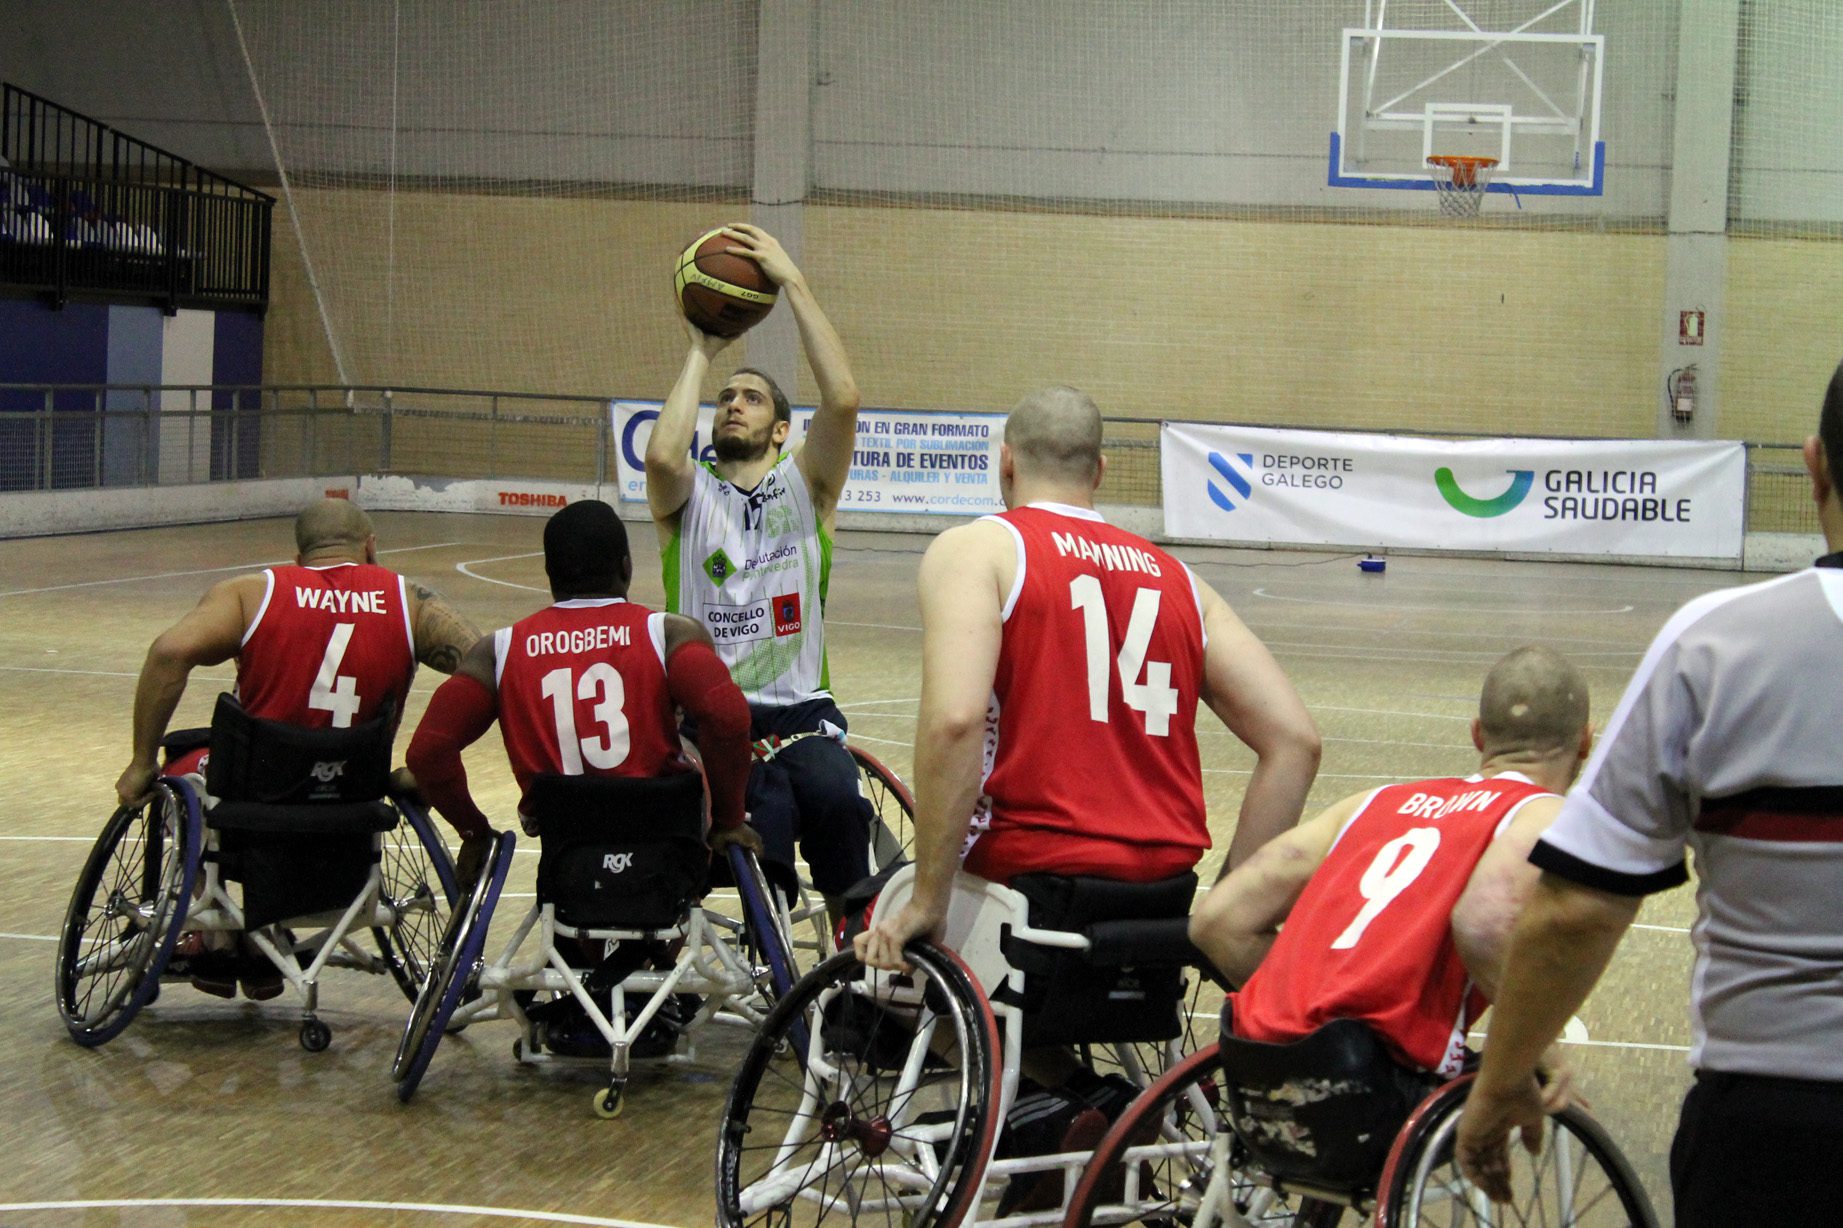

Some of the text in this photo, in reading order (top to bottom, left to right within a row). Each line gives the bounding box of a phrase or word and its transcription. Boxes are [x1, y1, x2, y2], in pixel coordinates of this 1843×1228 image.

[875, 421, 890, 434] EN
[894, 422, 928, 436] GRAN
[932, 423, 989, 438] FORMATO
[861, 436, 892, 448] TEXTIL
[896, 438, 917, 449] POR
[852, 450, 989, 471] TURA DE EVENTOS
[1263, 454, 1353, 472] DEPORTE
[849, 468, 879, 481] URAS
[889, 470, 940, 484] ALQUILER
[944, 472, 951, 484] Y
[955, 472, 988, 485] VENTA
[1262, 472, 1343, 490] GALEGO
[1545, 469, 1657, 494] GALICIA
[498, 492, 568, 507] TOSHIBA
[857, 490, 881, 503] 253
[892, 493, 1005, 507] www.cordecom.c
[1544, 496, 1691, 523] SAUDABLE
[1051, 531, 1162, 578] MANNING
[295, 586, 388, 615] WAYNE
[707, 607, 765, 624] CONCELLO
[714, 623, 760, 638] DE VIGO
[777, 621, 801, 633] VIGO
[526, 625, 631, 657] OROGBEMI
[1069, 574, 1179, 737] 14
[308, 622, 361, 729] 4
[541, 662, 631, 776] 13
[1397, 790, 1503, 819] BROWN
[602, 852, 634, 874] RGK
[1330, 826, 1441, 950] 9
